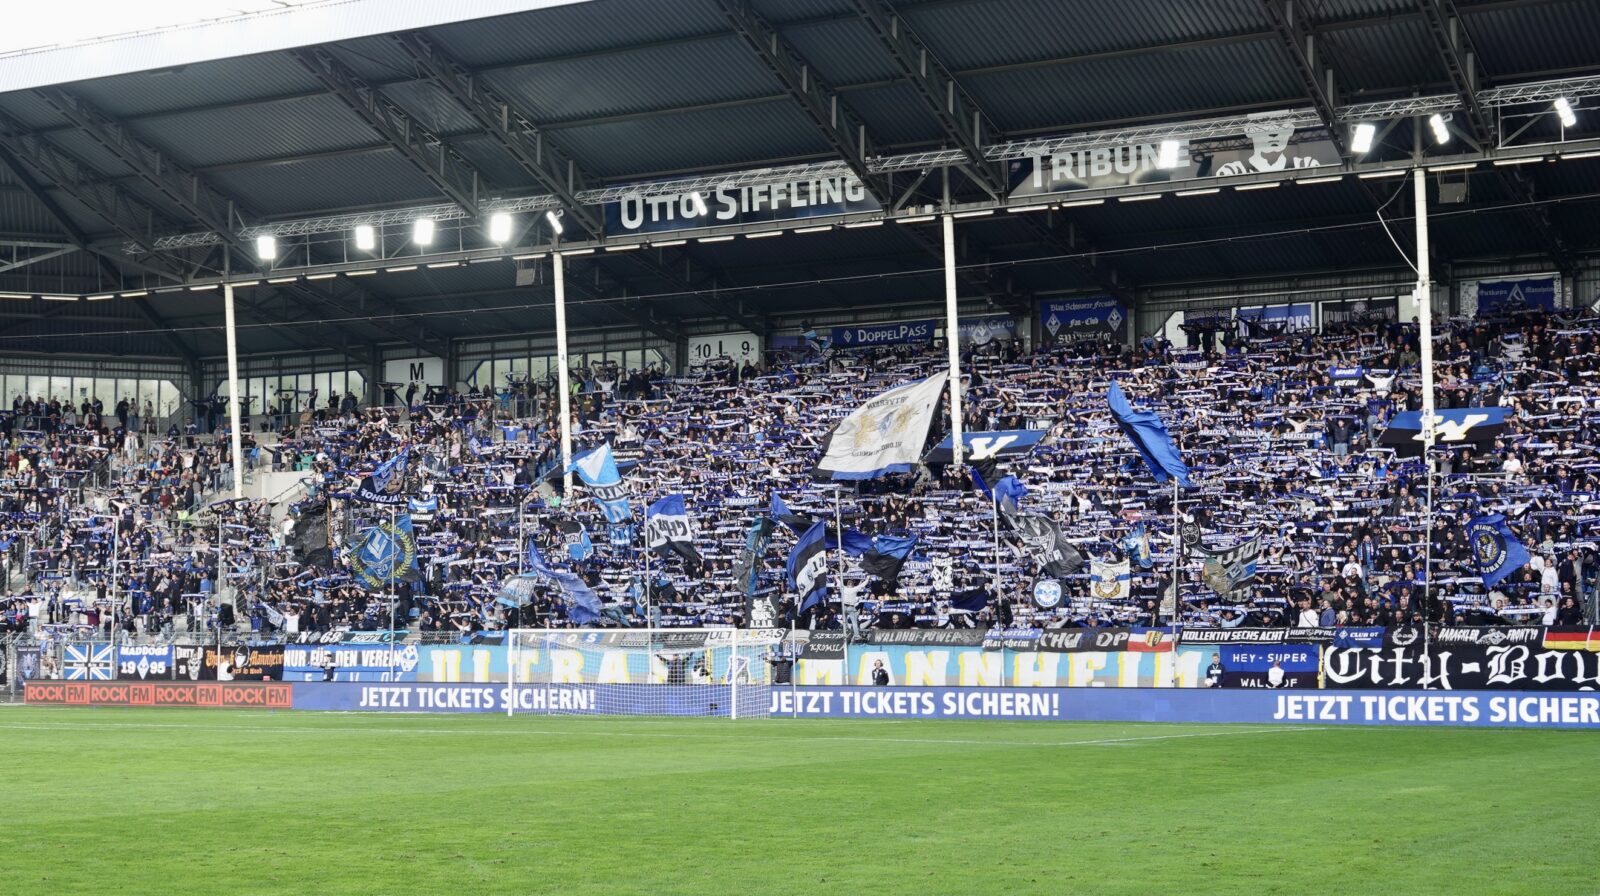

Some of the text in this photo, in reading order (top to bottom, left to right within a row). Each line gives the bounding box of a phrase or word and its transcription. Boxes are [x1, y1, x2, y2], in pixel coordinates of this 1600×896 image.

[716, 175, 864, 220] SIFFLING
[695, 344, 711, 359] 10
[742, 342, 750, 356] 9
[411, 363, 424, 380] M
[1182, 630, 1231, 641] KOLLEKTIV
[1232, 630, 1258, 641] SECHS
[1260, 630, 1283, 641] ACHT
[120, 646, 168, 656] MADDOGS
[284, 650, 306, 667] NUR
[335, 650, 358, 667] DEN
[362, 650, 403, 667] VEREIN
[1233, 653, 1255, 663] HEY
[1268, 653, 1307, 663] SUPER
[121, 661, 166, 674] 19 95
[1241, 678, 1298, 688] WALOF
[27, 686, 287, 703] ROCK FM ROCK FM ROCK FM ROCK FM
[359, 687, 596, 709] JETZT TICKETS SICHERN!
[770, 691, 1059, 716] JETZT TICKETS SICHERN!
[1274, 695, 1352, 720] JETZT
[1360, 696, 1480, 722] TICKETS
